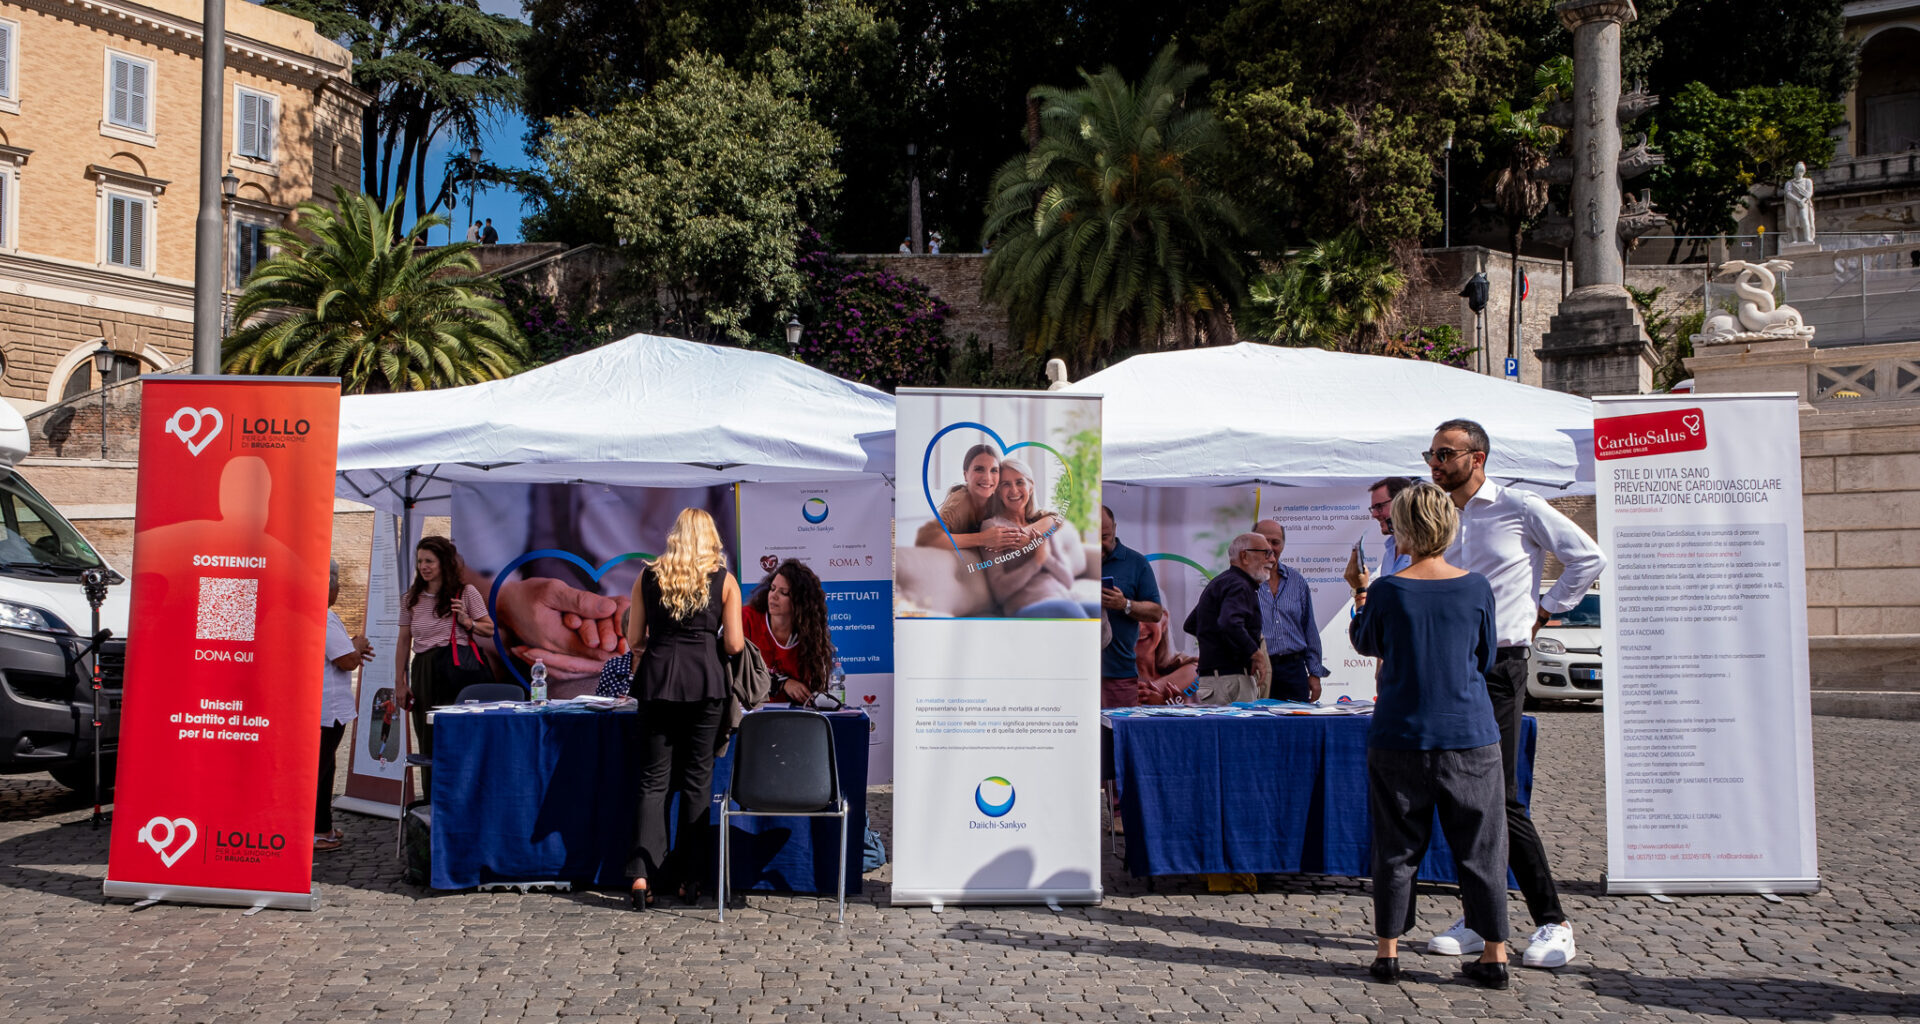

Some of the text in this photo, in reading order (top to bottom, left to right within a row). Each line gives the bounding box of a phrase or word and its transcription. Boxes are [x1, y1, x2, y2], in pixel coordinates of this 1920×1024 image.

[1508, 360, 1516, 375] P
[242, 418, 310, 435] LOLLO
[268, 435, 307, 443] SINDROME
[1597, 428, 1686, 450] CardioSalus
[1599, 448, 1632, 457] ASSOCIAZIONE
[1613, 467, 1710, 480] STILE DI VITA SANO
[1614, 479, 1782, 492] PREVENZIONE CARDIOVASCOLARE
[1614, 491, 1769, 505] RIABILITAZIONE CARDIOLOGICA
[1272, 515, 1320, 523] rappresentano
[1329, 514, 1349, 522] prima
[967, 563, 975, 574] Il
[976, 559, 993, 570] tuo
[994, 549, 1022, 564] cuore
[1021, 536, 1044, 554] nelle
[1055, 498, 1071, 524] mani
[193, 555, 267, 568] SOSTIENICI!
[829, 558, 860, 567] ROMA
[825, 591, 879, 601] FFETTUATI
[830, 613, 852, 621] (ECG)
[194, 650, 254, 663] DONA QUI
[1343, 659, 1373, 668] ROMA
[200, 699, 243, 711] Unisciti
[965, 705, 982, 713] prima
[170, 713, 270, 727] al battito di Lollo
[1003, 719, 1025, 727] significa
[178, 728, 259, 741] per la ricerca
[998, 726, 1014, 735] quella
[1015, 726, 1029, 734] delle
[968, 820, 1027, 832] Daiichi-Sankyo
[216, 830, 286, 850] LOLLO
[224, 855, 261, 864] BRUGADA
[243, 850, 282, 858] SINDROME
